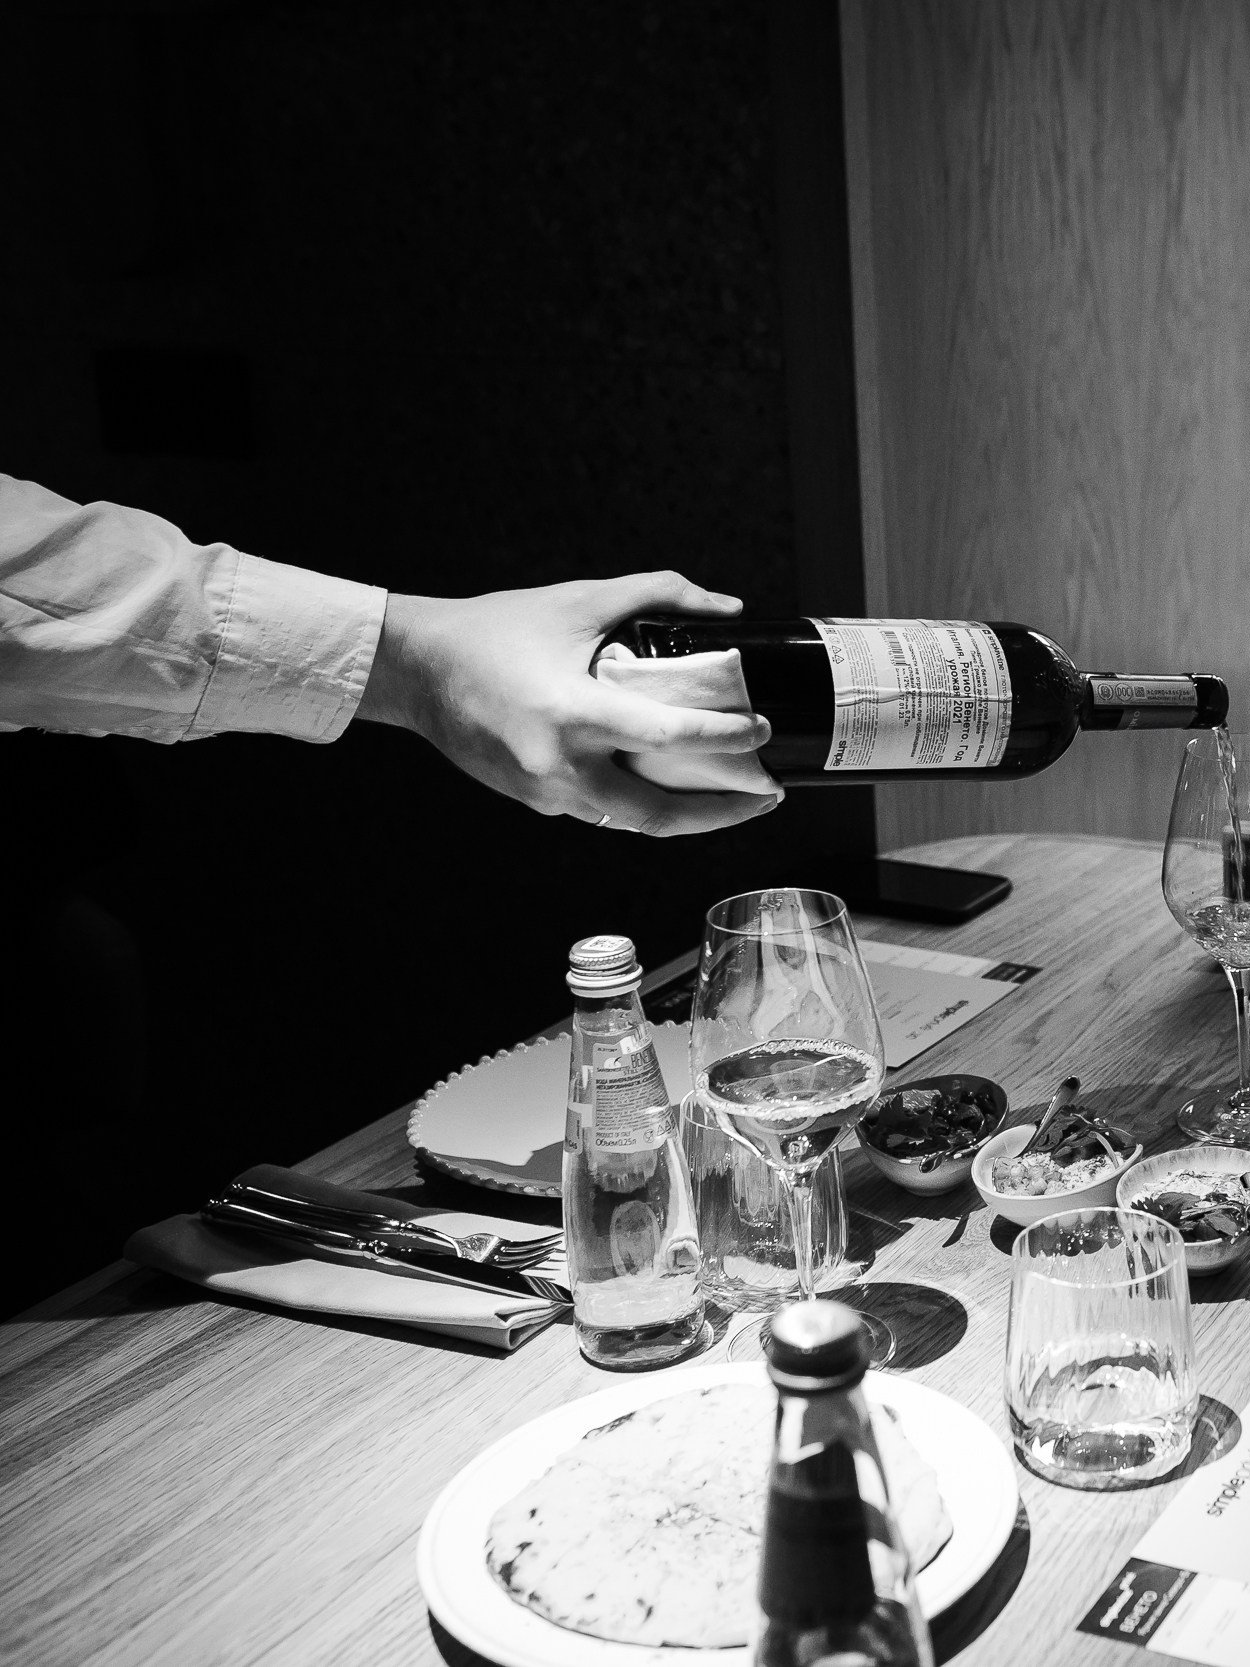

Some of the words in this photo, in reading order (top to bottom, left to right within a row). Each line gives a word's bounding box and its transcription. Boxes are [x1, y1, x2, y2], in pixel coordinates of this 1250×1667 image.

[946, 629, 965, 660] Италия.
[945, 659, 961, 698] урожая
[959, 662, 972, 699] Регион
[952, 700, 963, 725] 2021
[960, 701, 974, 743] Венето.
[832, 740, 848, 768] simple
[953, 745, 969, 762] Год
